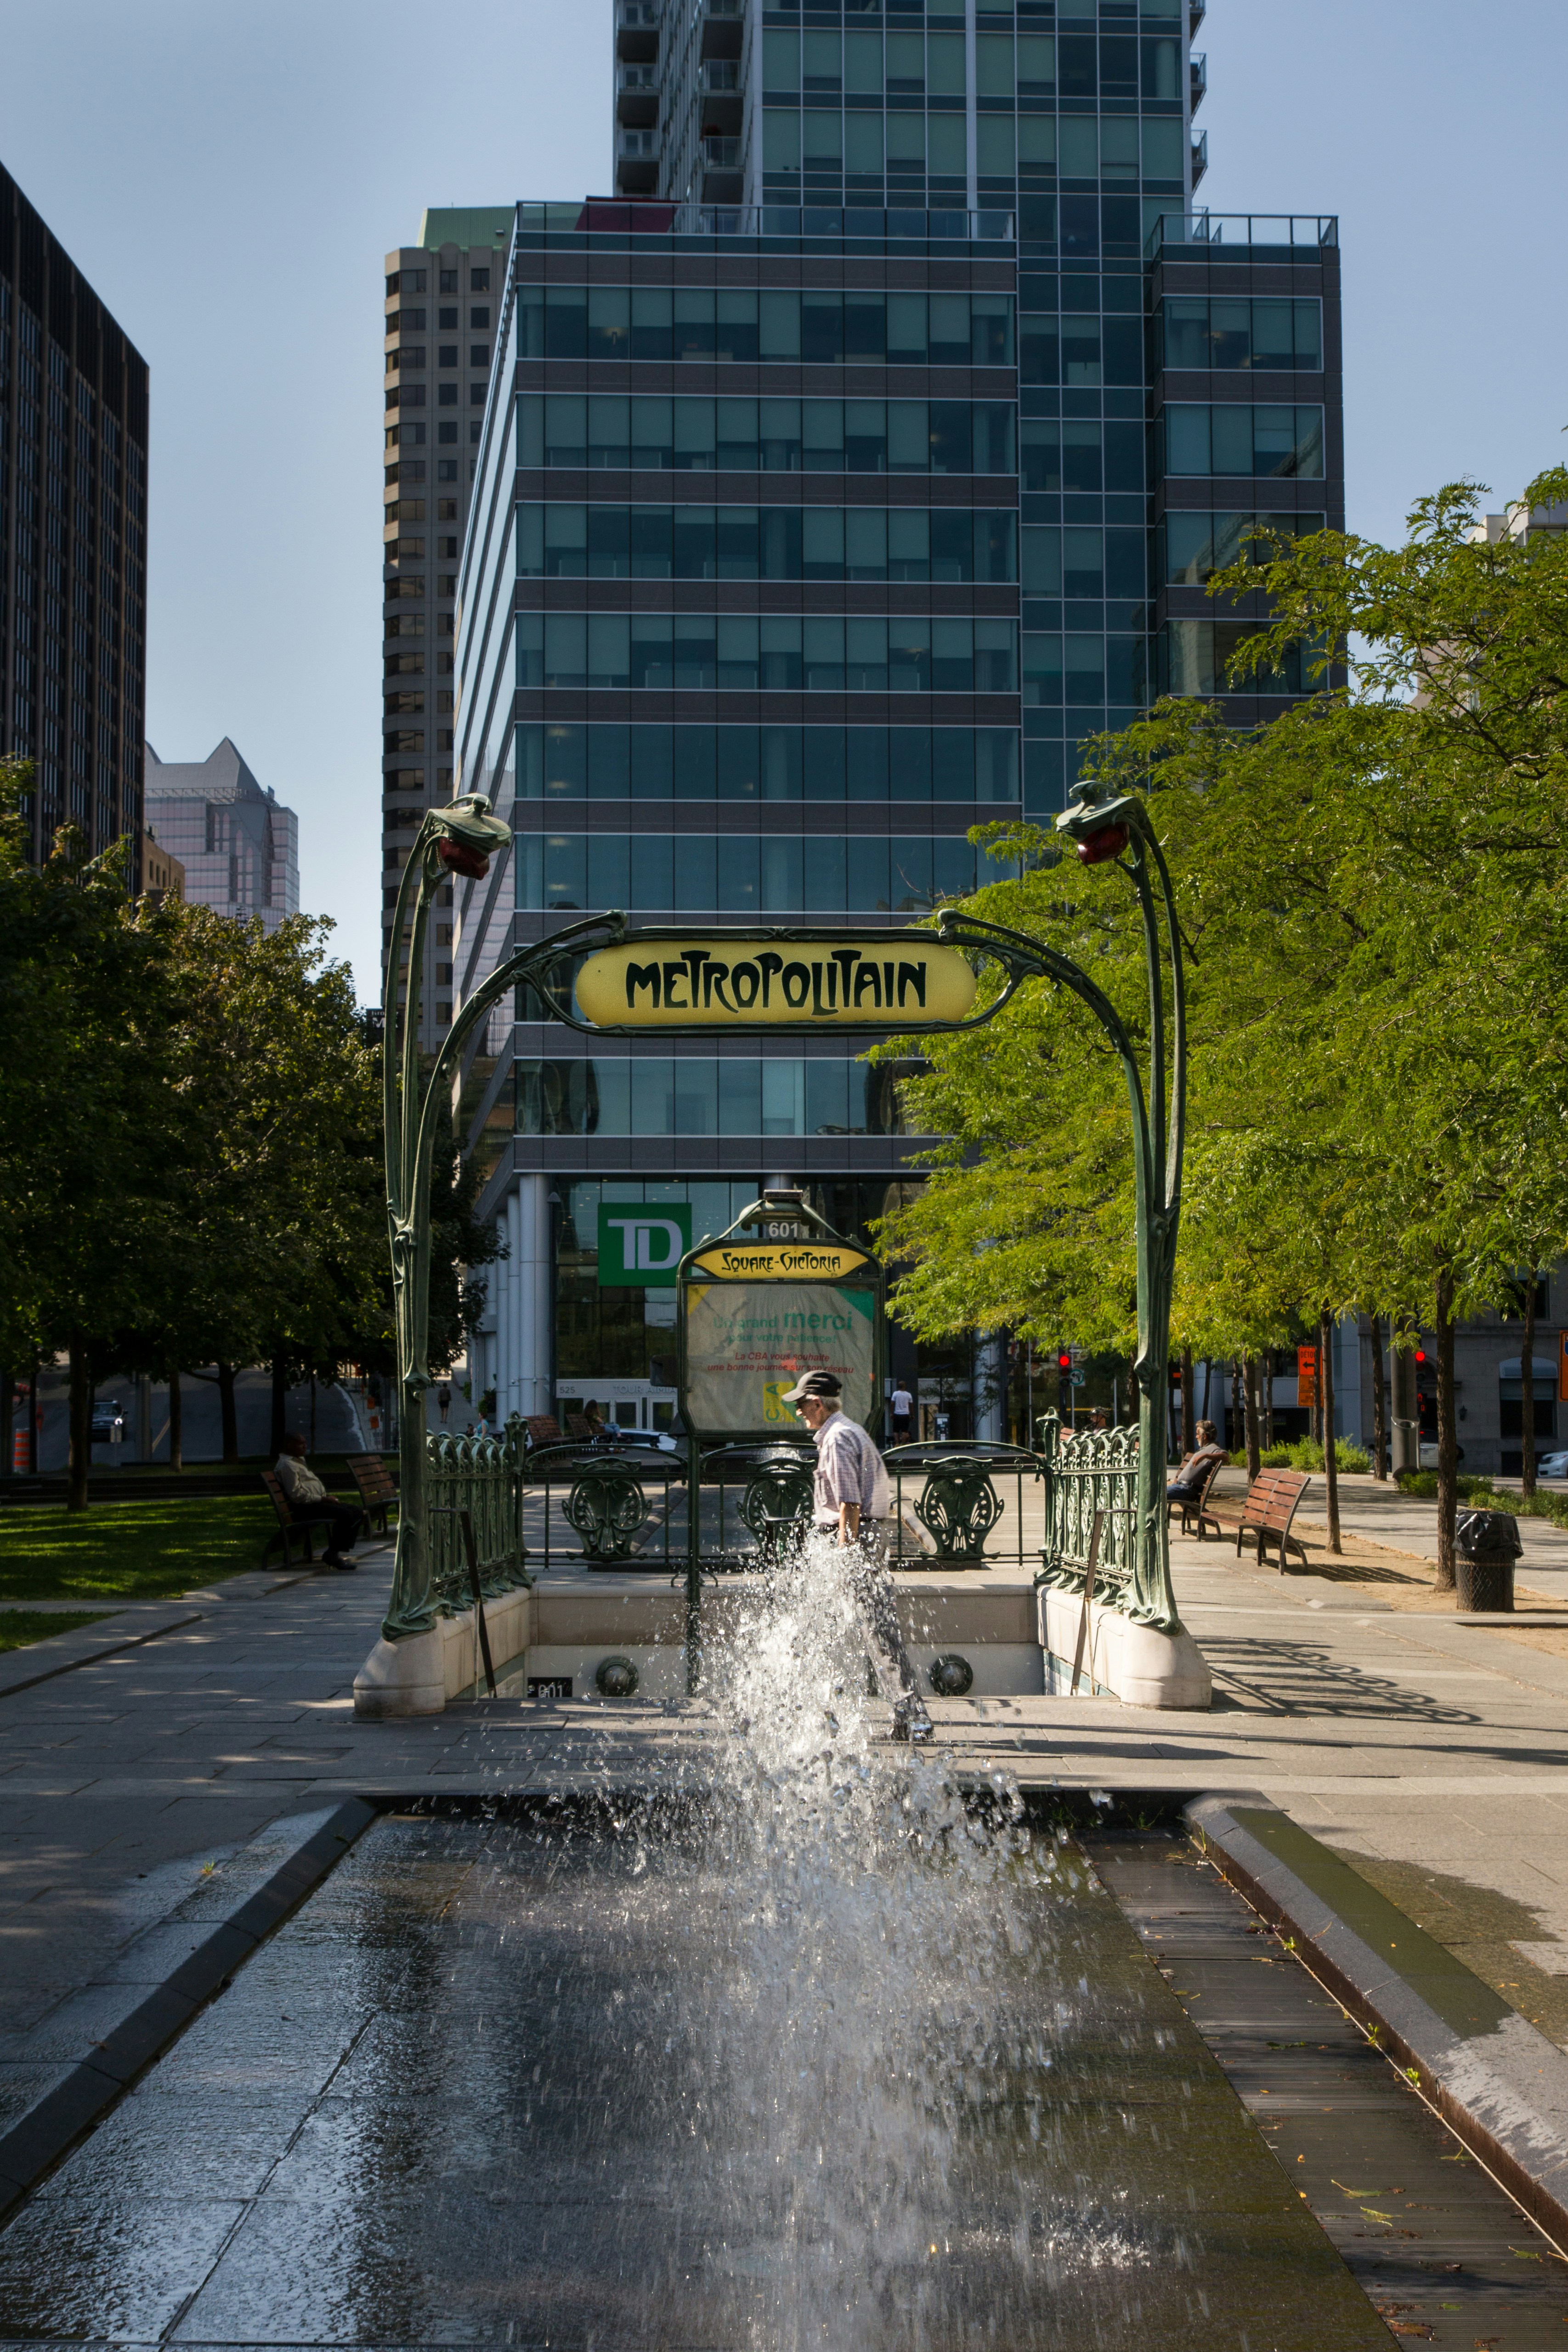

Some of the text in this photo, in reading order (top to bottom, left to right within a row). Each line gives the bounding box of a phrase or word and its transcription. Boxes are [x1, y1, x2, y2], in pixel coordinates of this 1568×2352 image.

[625, 949, 927, 1016] METROPOLITAIN
[769, 1222, 798, 1237] 601
[607, 1219, 683, 1269] TD
[713, 1311, 852, 1332] Un grand merci
[728, 1333, 836, 1346] pour votre patience!
[735, 1352, 745, 1361] La
[748, 1352, 768, 1361] CBA
[793, 1353, 830, 1362] souhaite
[1300, 1350, 1315, 1358] DÉTO
[756, 1363, 788, 1372] journée
[824, 1364, 854, 1374] réseau
[538, 1685, 563, 1698] 601
